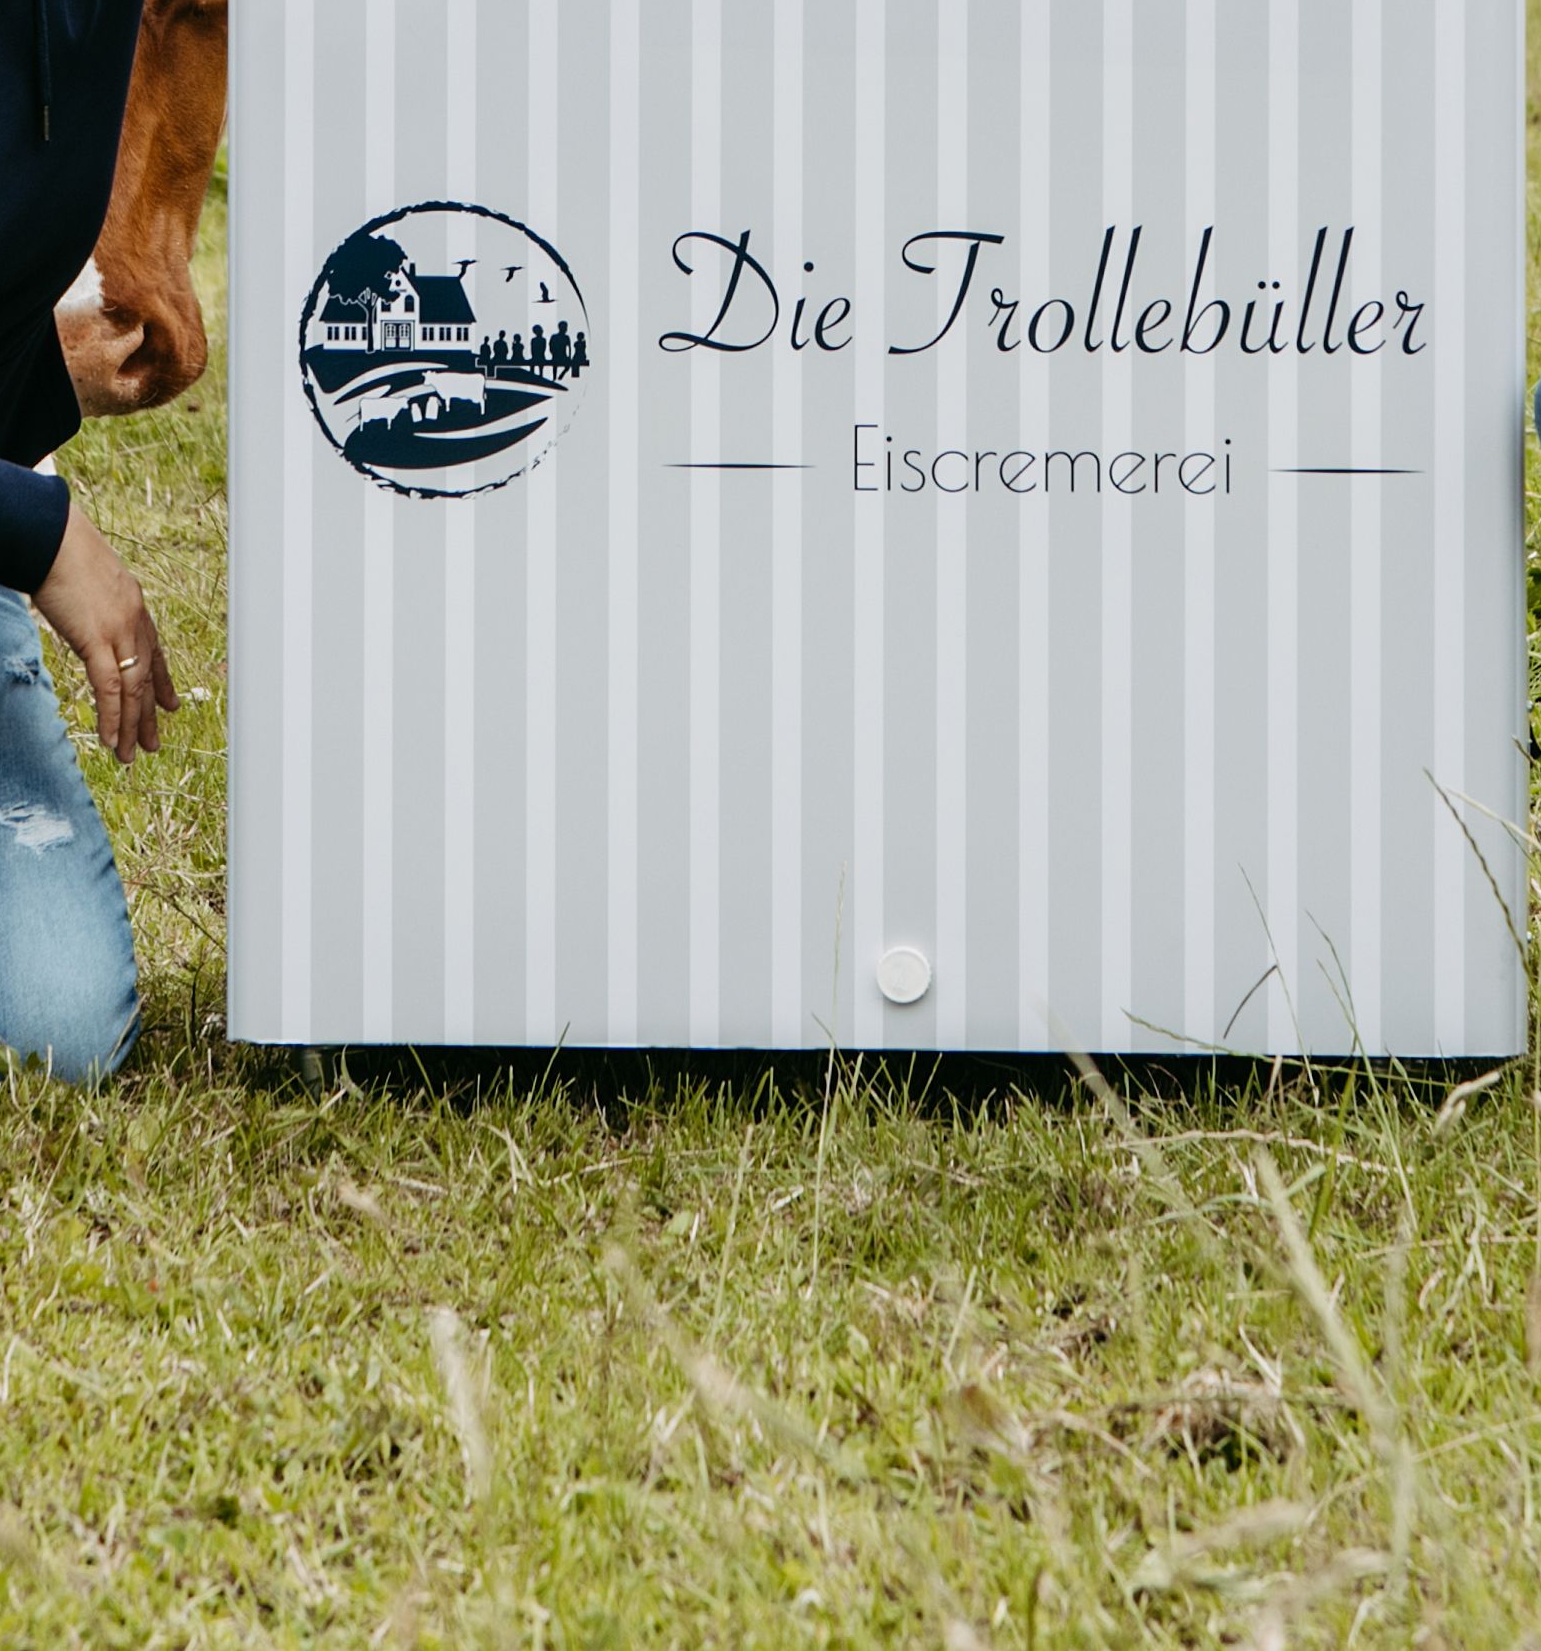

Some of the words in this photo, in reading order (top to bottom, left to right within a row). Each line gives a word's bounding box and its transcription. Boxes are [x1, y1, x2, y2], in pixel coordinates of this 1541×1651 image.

[658, 225, 853, 354] Die
[887, 224, 1428, 356] Trollebüller
[853, 424, 1234, 496] Eiscremerei
